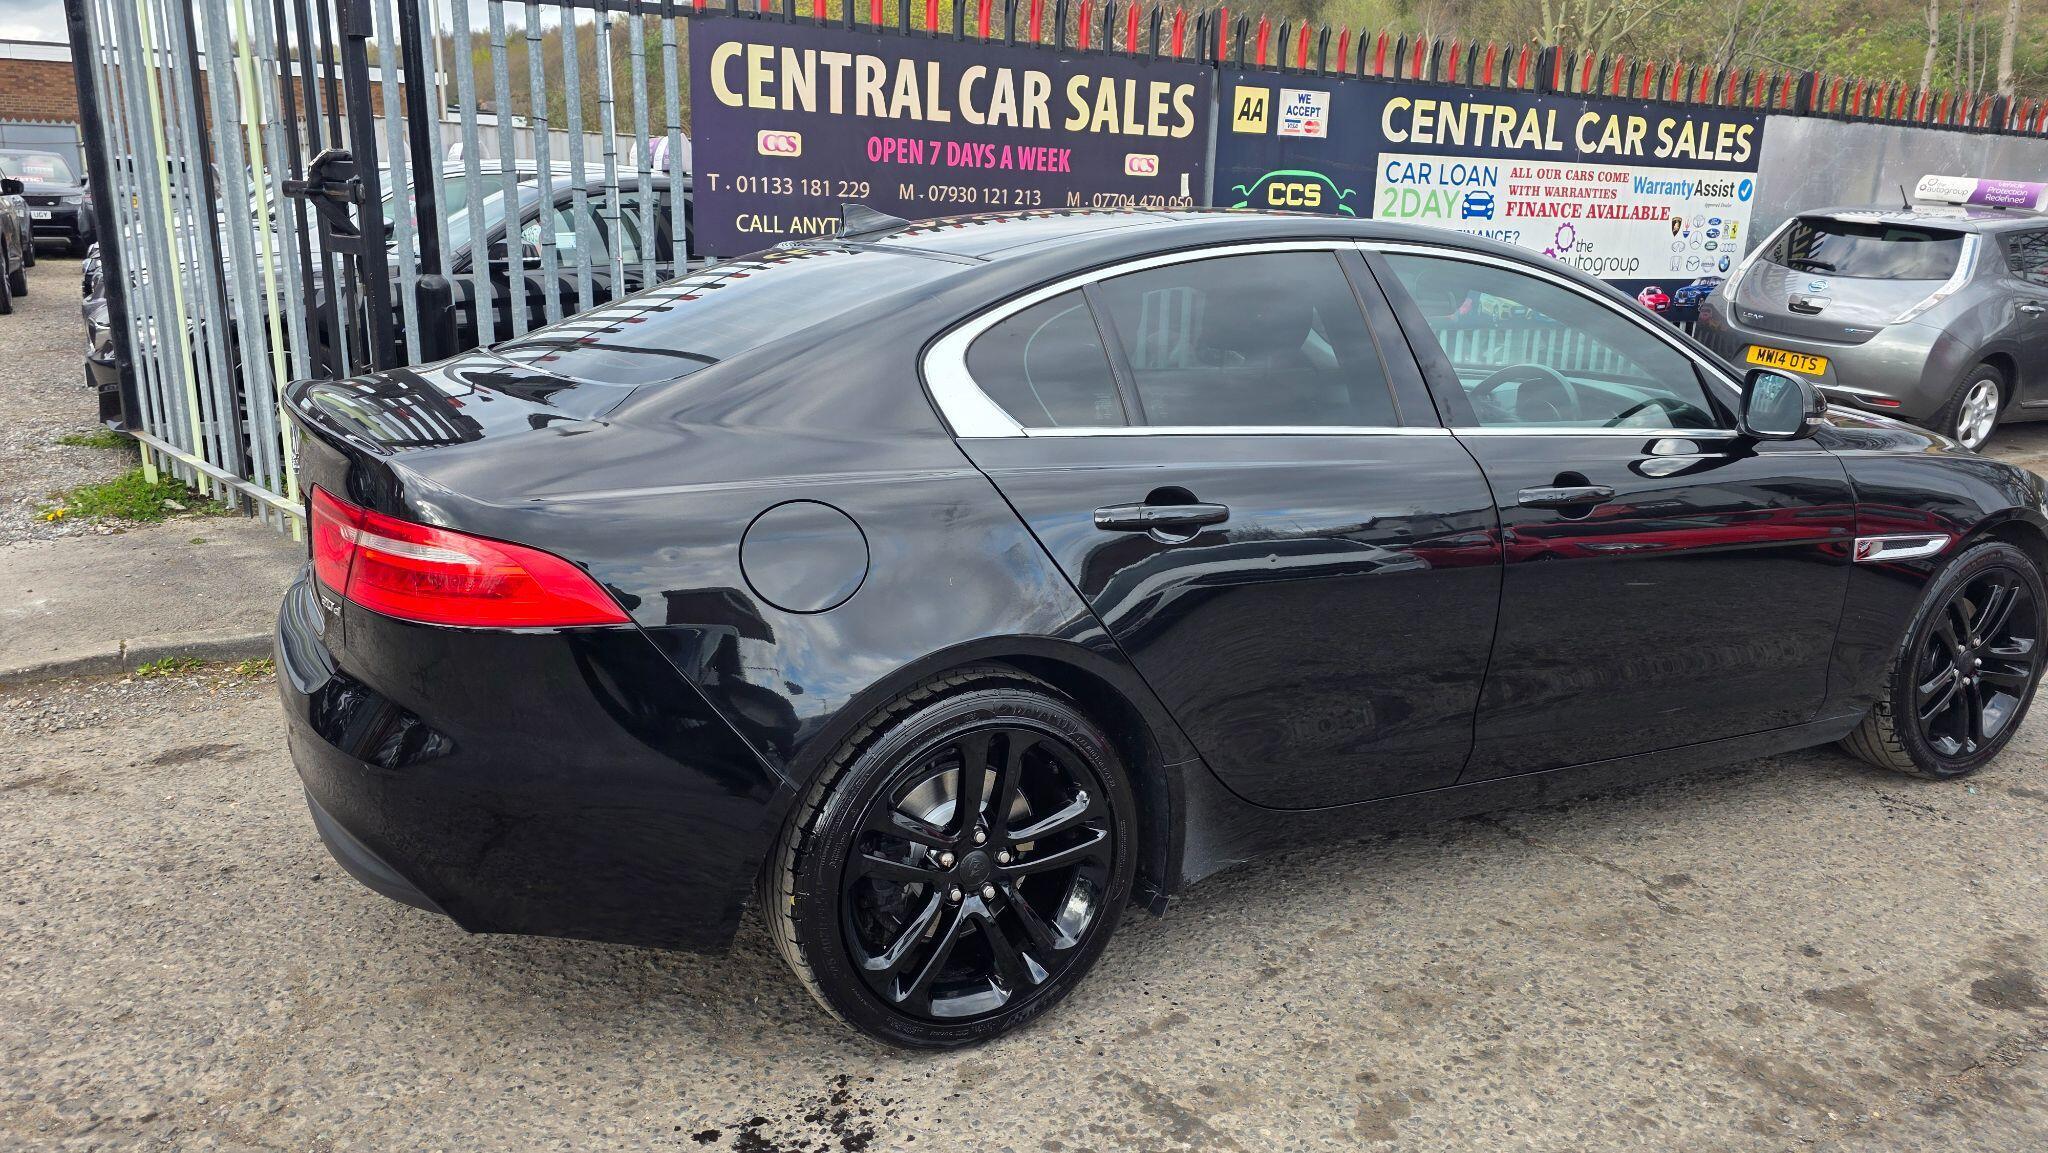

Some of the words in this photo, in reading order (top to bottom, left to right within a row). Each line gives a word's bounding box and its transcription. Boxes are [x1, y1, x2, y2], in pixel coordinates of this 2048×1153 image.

[710, 41, 951, 123] CENTRAL
[958, 65, 1052, 130] CAR
[1064, 74, 1195, 138] SALES
[1298, 93, 1312, 104] WE
[1237, 97, 1264, 122] AA
[1286, 105, 1321, 117] ACCEPT
[1380, 96, 1563, 152] CENTRAL
[1574, 111, 1648, 157] CAR
[1653, 116, 1754, 163] SALES
[867, 136, 924, 165] OPEN
[929, 141, 942, 166] 7
[946, 141, 996, 169] DAYS
[999, 145, 1013, 170] A
[1017, 146, 1072, 173] WEEK
[1385, 160, 1432, 185] CAR
[1439, 163, 1498, 187] LOAN
[1510, 167, 1533, 179] ALL
[1536, 168, 1562, 180] OUR
[1565, 169, 1595, 181] CARS
[1597, 171, 1630, 183] COME
[735, 175, 794, 195] 01133
[800, 179, 831, 197] 181
[836, 180, 870, 199] 229
[928, 185, 977, 203] 07930
[982, 188, 1009, 205] 121
[1014, 189, 1041, 206] 213
[1268, 182, 1322, 207] CCS
[1508, 184, 1541, 197] WITH
[1544, 186, 1618, 200] WARRANTIES
[1926, 186, 1969, 196] autogroup
[1987, 186, 2028, 196] Protection
[1092, 192, 1135, 208] 07704
[1139, 194, 1165, 208] 470
[1382, 186, 1461, 219] 2DAY
[1985, 193, 2026, 204] Redefined
[1505, 201, 1583, 219] FINANCE
[1586, 203, 1671, 221] AVAILABLE
[735, 214, 783, 234] CALL
[789, 216, 842, 235] ANYT
[1575, 239, 1594, 253] the
[1756, 348, 1786, 364] MW14
[1789, 354, 1819, 371] OTS
